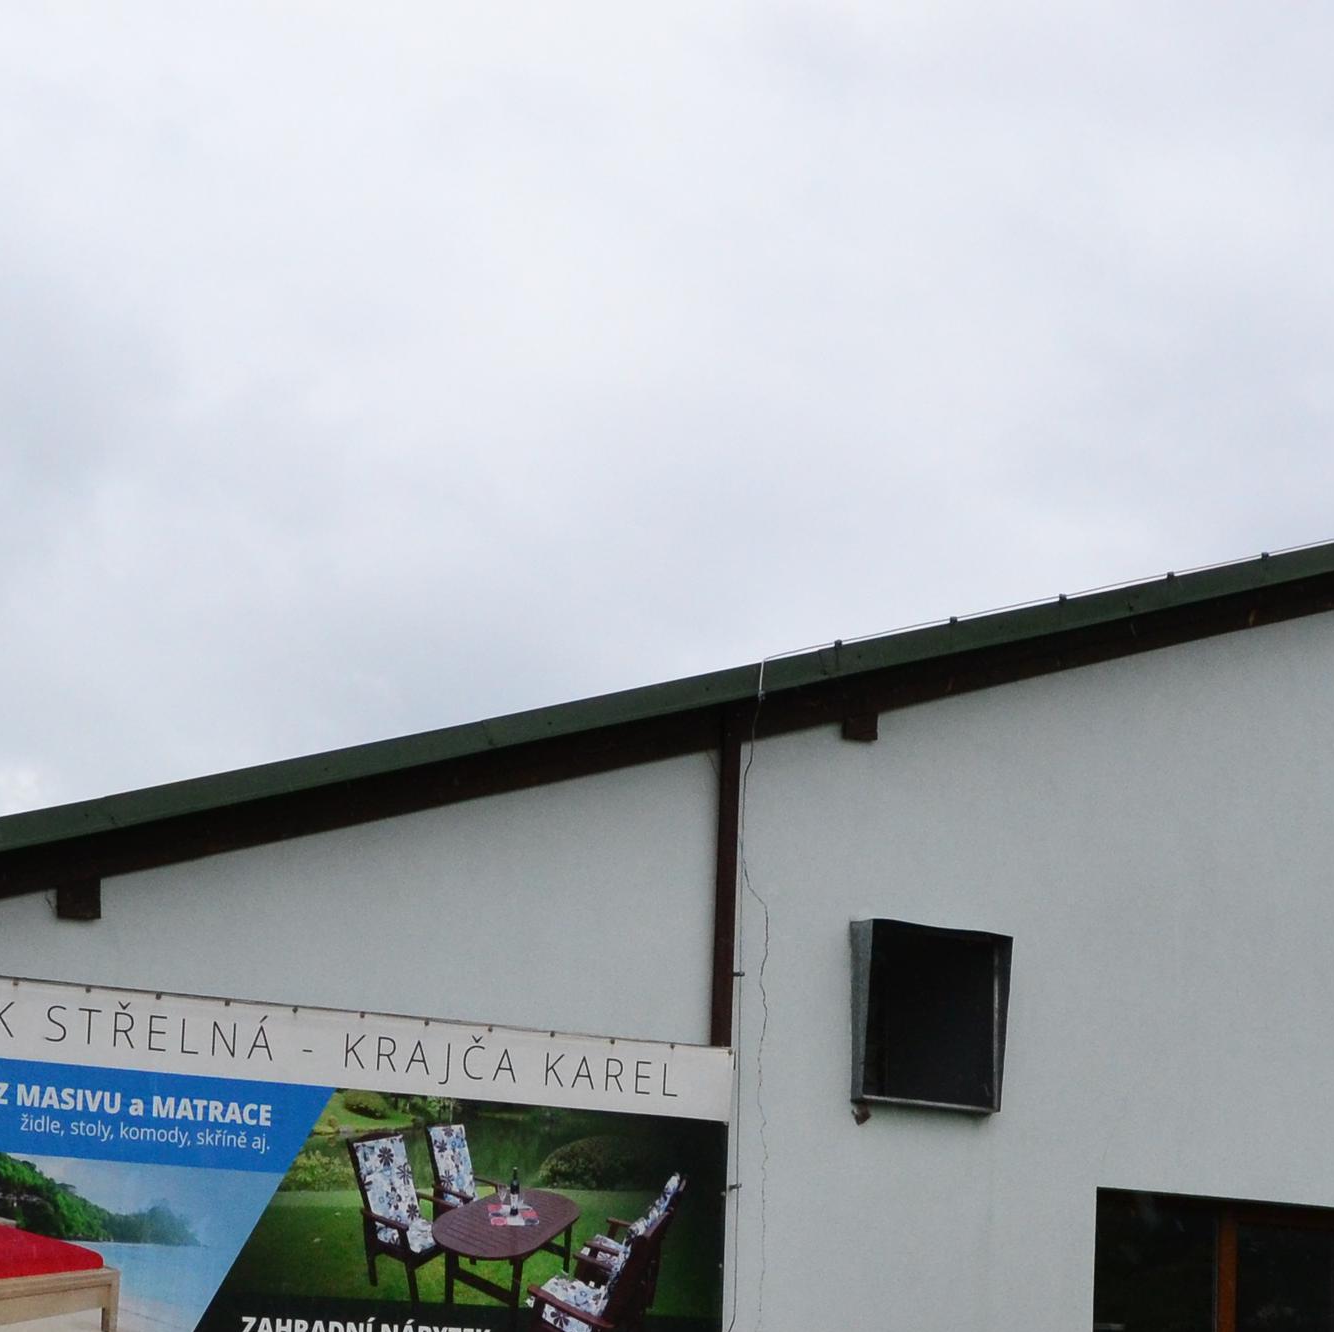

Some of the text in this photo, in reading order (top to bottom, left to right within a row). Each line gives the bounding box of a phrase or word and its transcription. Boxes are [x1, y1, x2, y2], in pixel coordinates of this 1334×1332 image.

[44, 1001, 273, 1061] STŘELNÁ
[344, 1033, 516, 1085] KRAJČA
[544, 1052, 679, 1097] KAREL
[16, 1084, 121, 1114] MASIVU
[129, 1099, 144, 1116] a
[152, 1096, 272, 1127] MATRACE
[20, 1113, 270, 1154] židle, stoly, komody, skříně aj.
